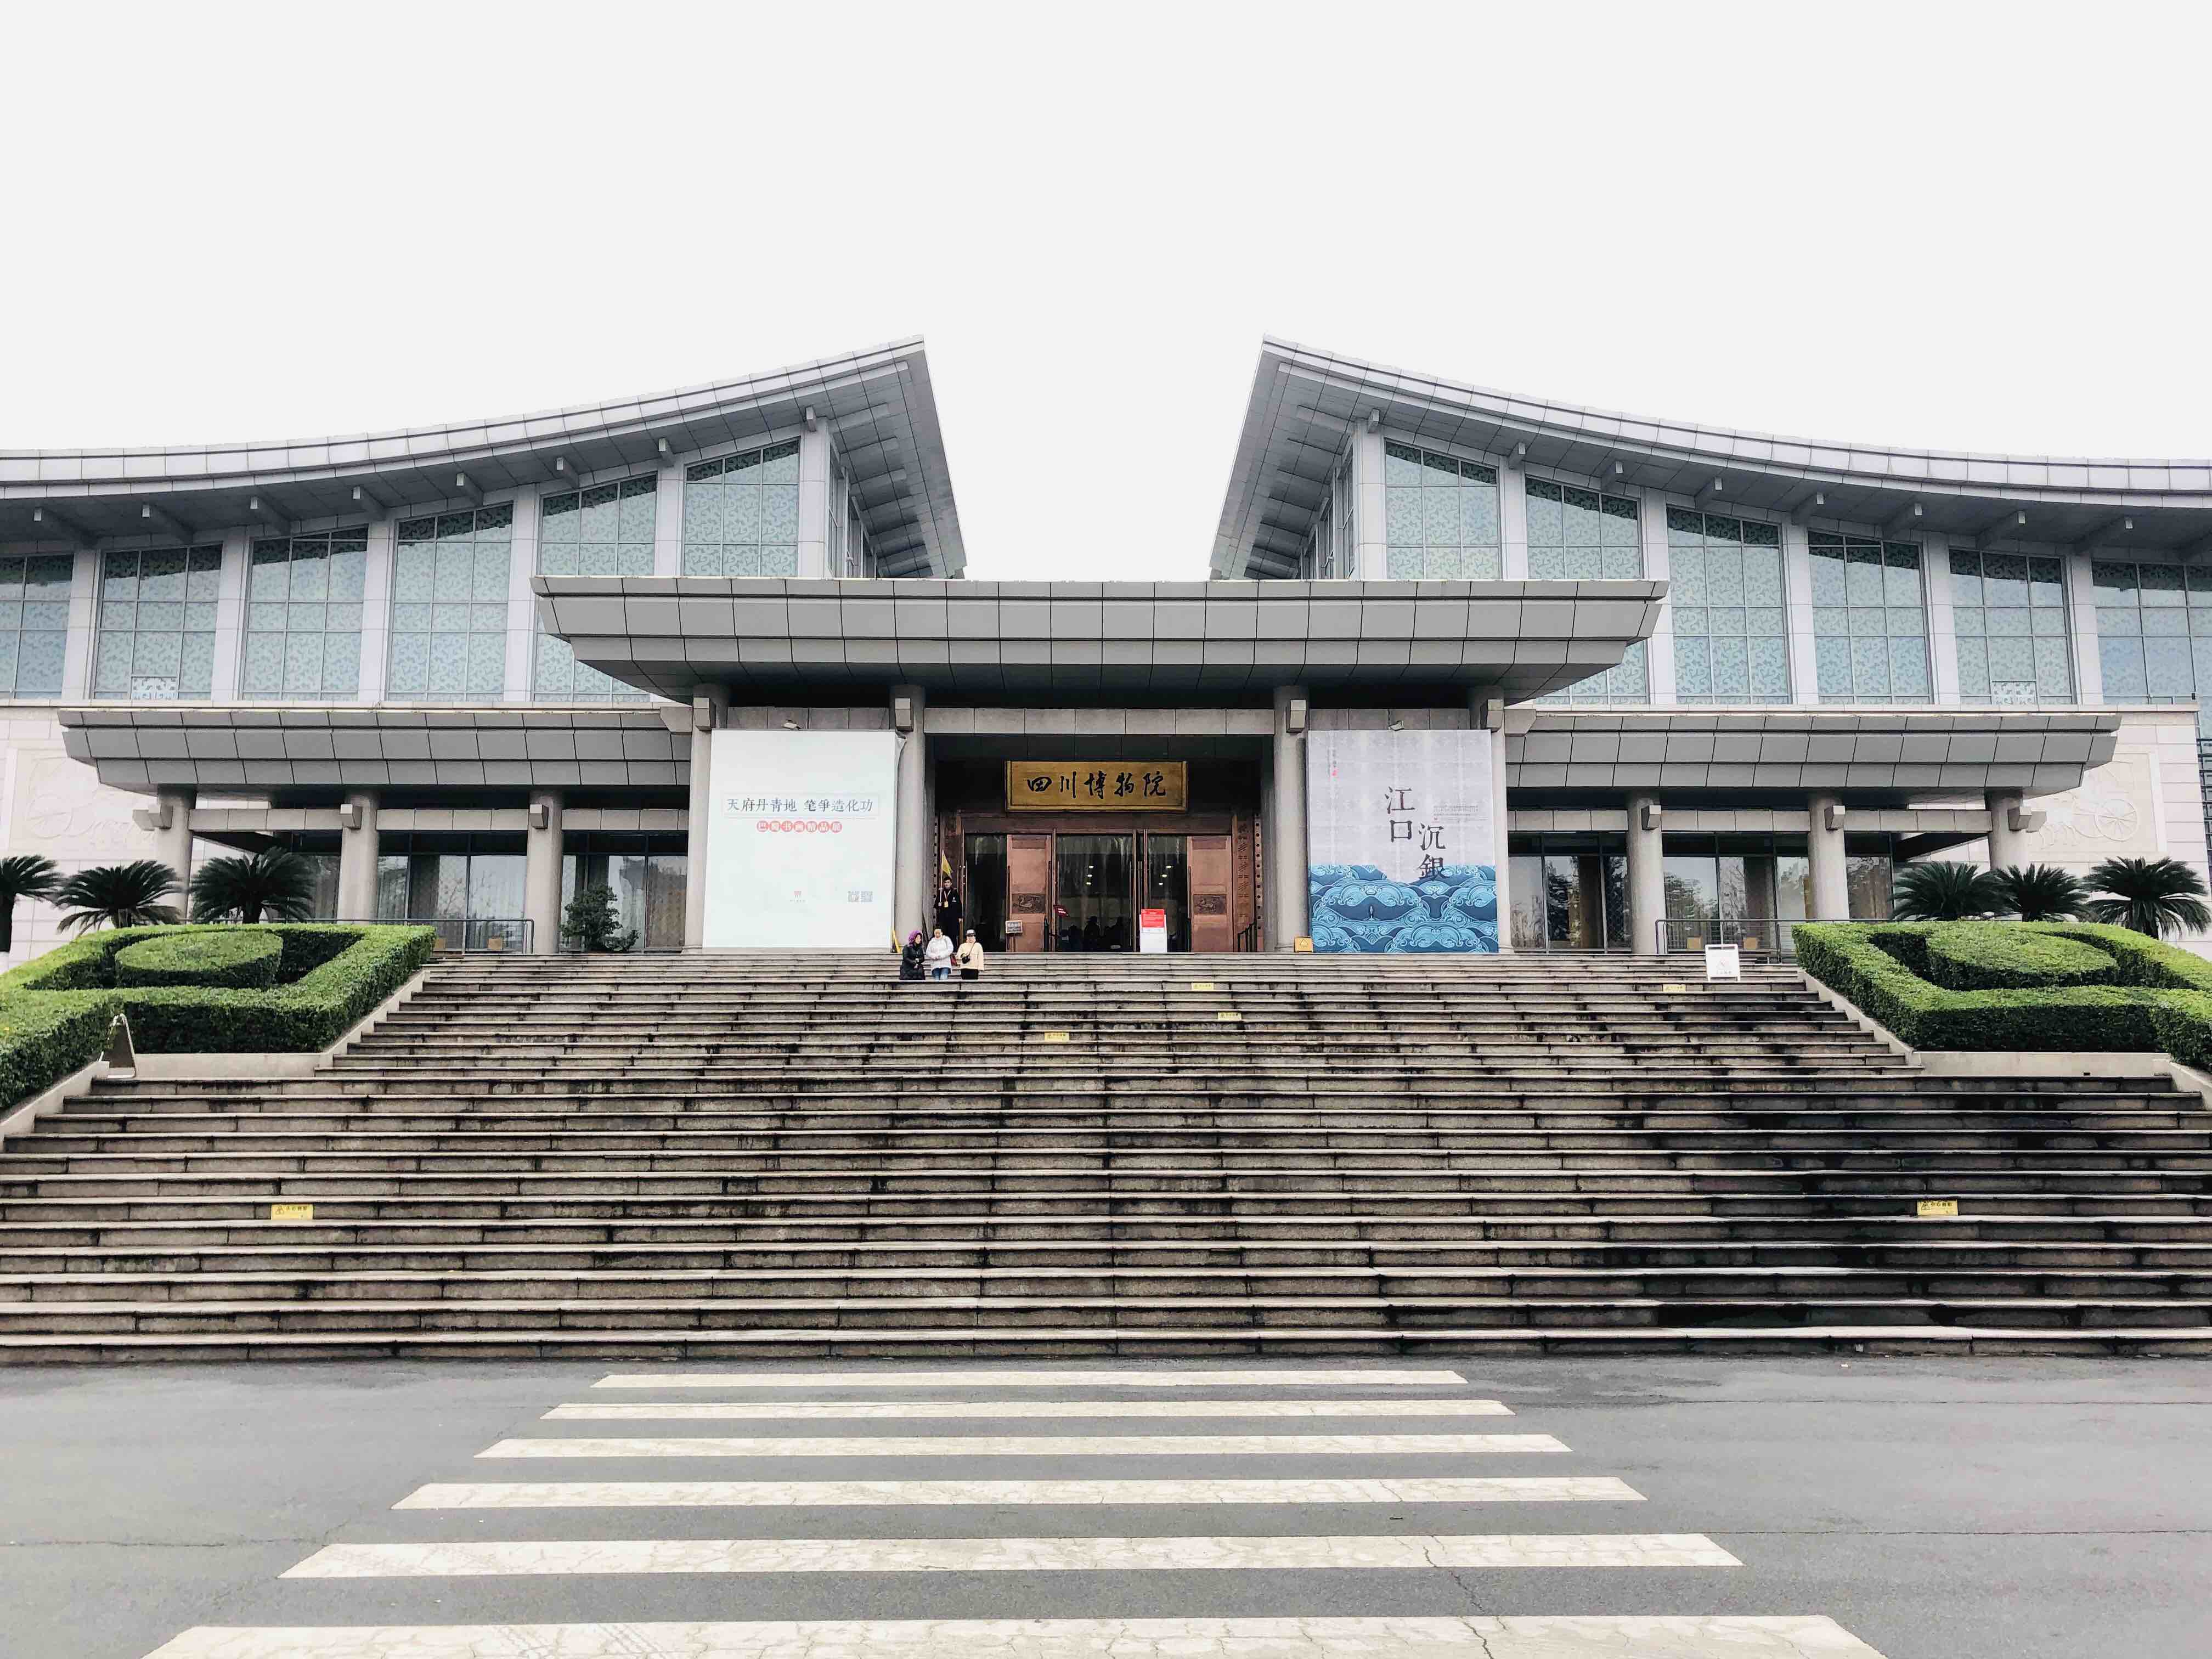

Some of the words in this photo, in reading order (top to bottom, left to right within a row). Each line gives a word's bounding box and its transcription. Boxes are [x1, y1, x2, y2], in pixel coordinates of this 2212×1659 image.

[1026, 770, 1166, 799] 四川博物院
[727, 798, 797, 812] 天府丹青地
[1384, 786, 1416, 843] 江口
